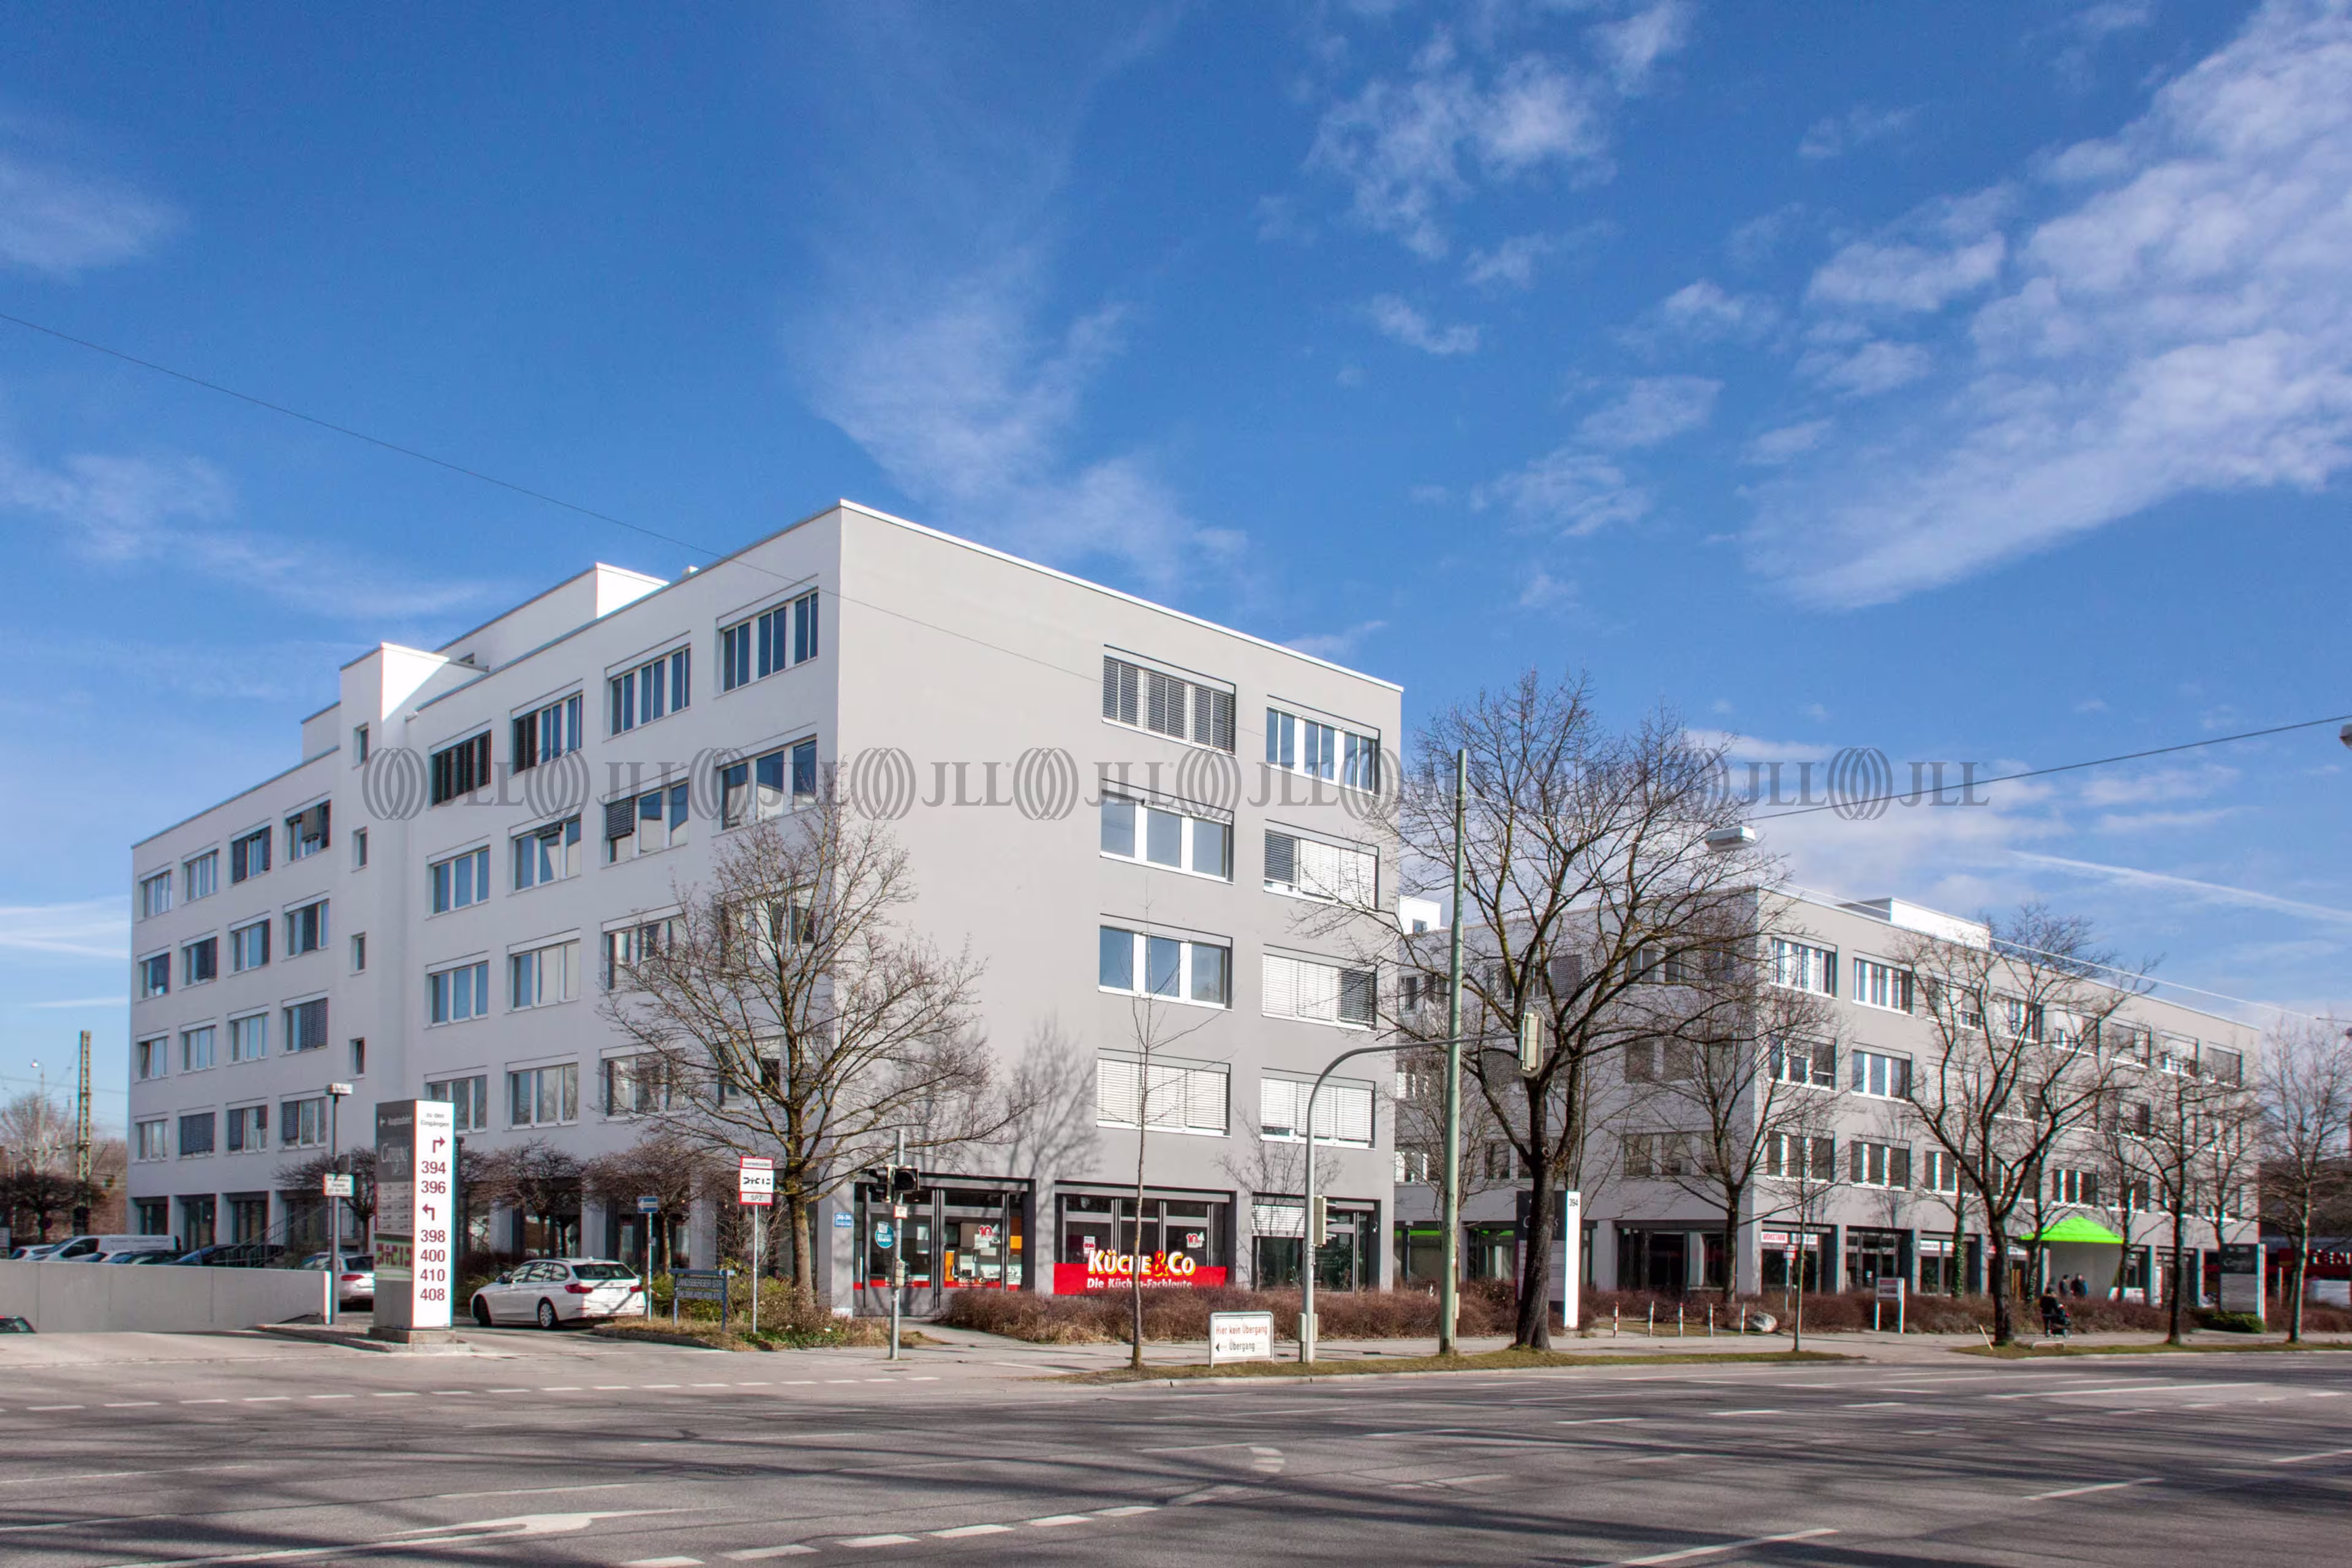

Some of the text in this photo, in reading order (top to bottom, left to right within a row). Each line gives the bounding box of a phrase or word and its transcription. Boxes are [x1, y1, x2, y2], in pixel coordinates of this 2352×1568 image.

[421, 1161, 447, 1174] 394
[421, 1180, 446, 1194] 396
[420, 1229, 446, 1243] 398
[420, 1249, 446, 1262] 400
[420, 1268, 445, 1282] 410
[1087, 1278, 1104, 1289] Die
[420, 1288, 445, 1301] 408
[1215, 1323, 1268, 1336] Hier kein Übergang
[1229, 1339, 1256, 1352] Übergang
